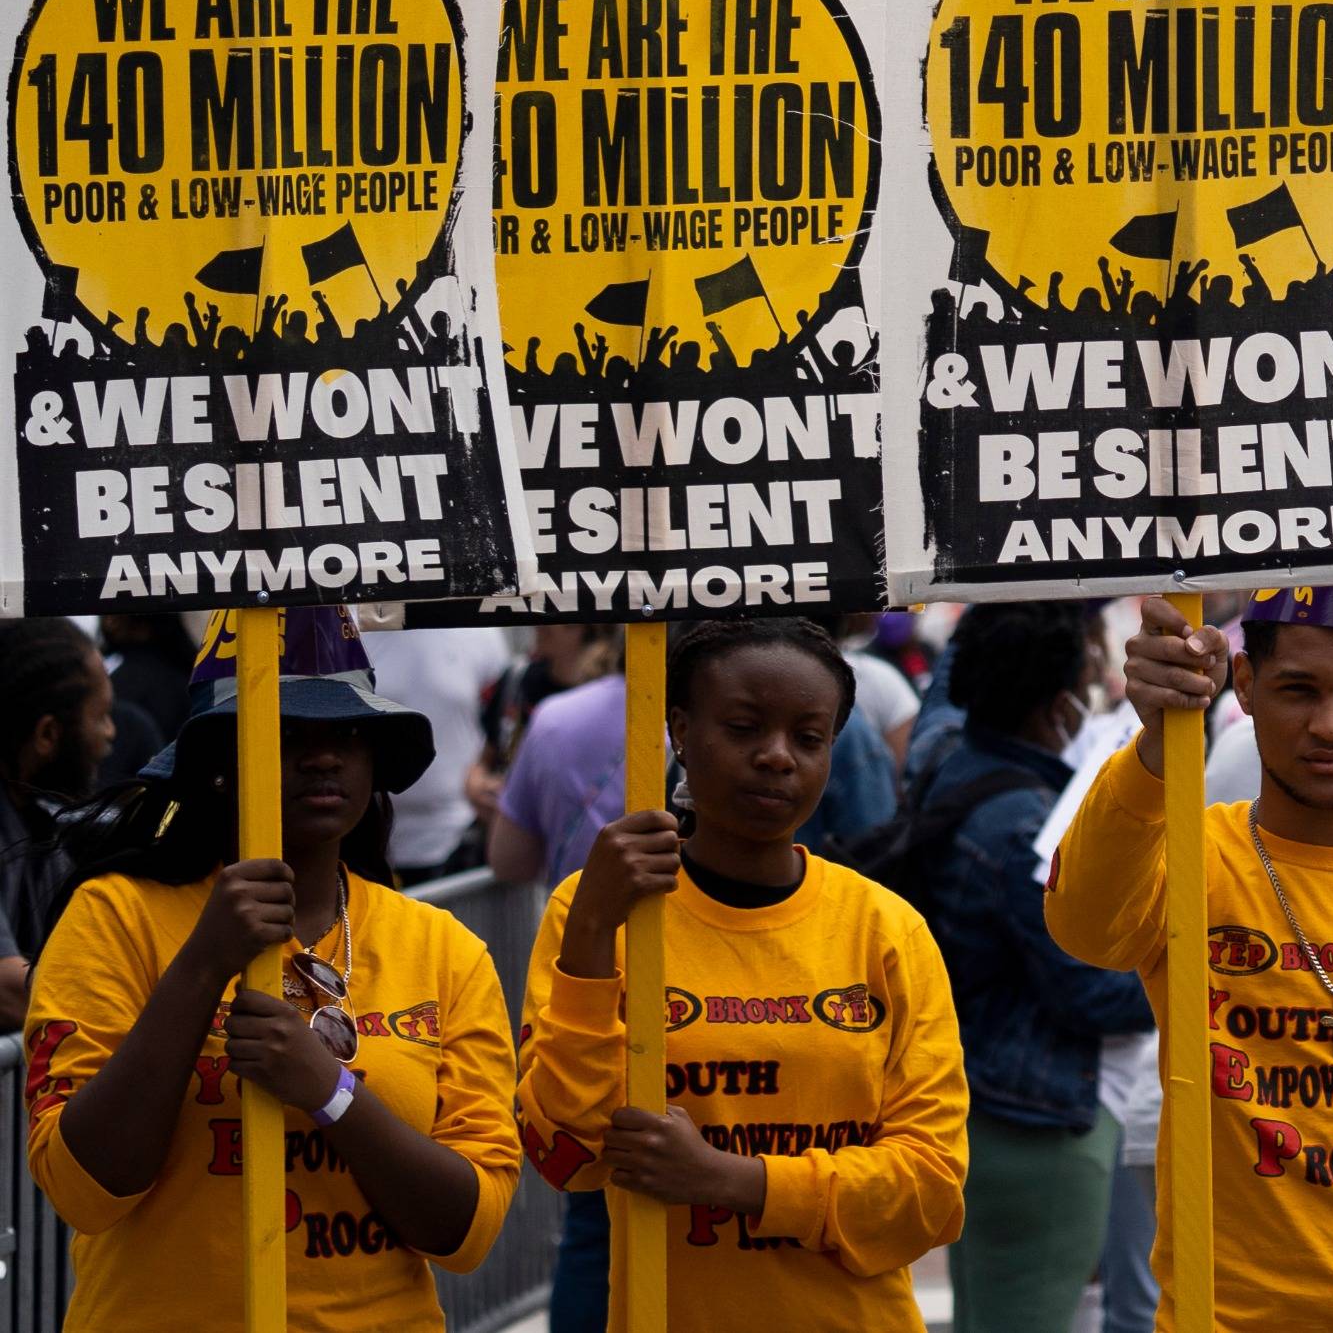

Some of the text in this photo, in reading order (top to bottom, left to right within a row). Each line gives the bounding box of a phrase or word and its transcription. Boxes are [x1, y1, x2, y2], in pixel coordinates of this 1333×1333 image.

[27, 50, 163, 177] 140
[189, 43, 450, 171] MILLION
[939, 13, 1082, 139] 140
[582, 80, 857, 209] MILLION
[954, 144, 1041, 187] POOR
[1053, 148, 1073, 184] &
[1087, 135, 1257, 183] LOW-WAGE
[44, 170, 438, 225] POOR & LOW-WAGE PEOPLE
[530, 214, 551, 253] &
[564, 207, 723, 252] LOW-WAGE
[733, 203, 844, 248] PEOPLE
[226, 366, 484, 443] WON'T
[611, 393, 880, 467] WON'T
[75, 455, 447, 539] BE SILENT
[978, 430, 1081, 503] BE
[524, 479, 842, 554] E SILENT
[100, 540, 445, 600] ANYMORE
[1209, 941, 1266, 967] YEP
[706, 996, 812, 1023] BRONX
[666, 1060, 780, 1098] OUTH
